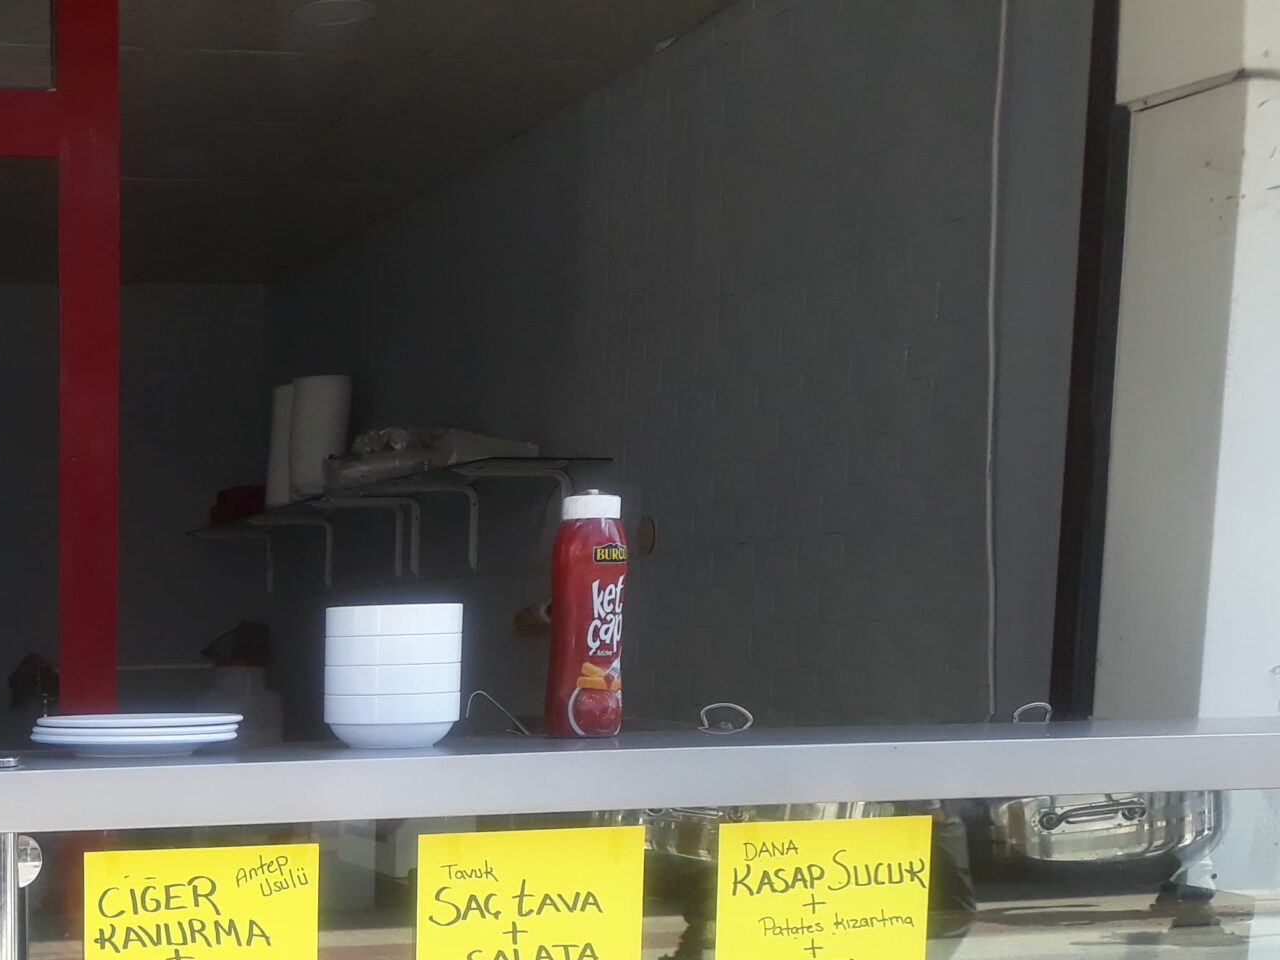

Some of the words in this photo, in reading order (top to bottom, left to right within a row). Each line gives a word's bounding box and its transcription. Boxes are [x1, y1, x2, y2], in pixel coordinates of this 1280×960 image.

[592, 575, 624, 619] ket
[743, 839, 799, 862] DANA
[236, 855, 289, 889] Antep
[260, 867, 309, 897] Usulü
[440, 860, 499, 882] Tavuk
[732, 863, 825, 897] KASAP
[827, 849, 927, 891] SUCUK
[802, 893, 827, 915] +
[93, 918, 273, 954] KAVURMA
[502, 921, 529, 945] +
[758, 915, 825, 938] Patates
[804, 938, 824, 958] +
